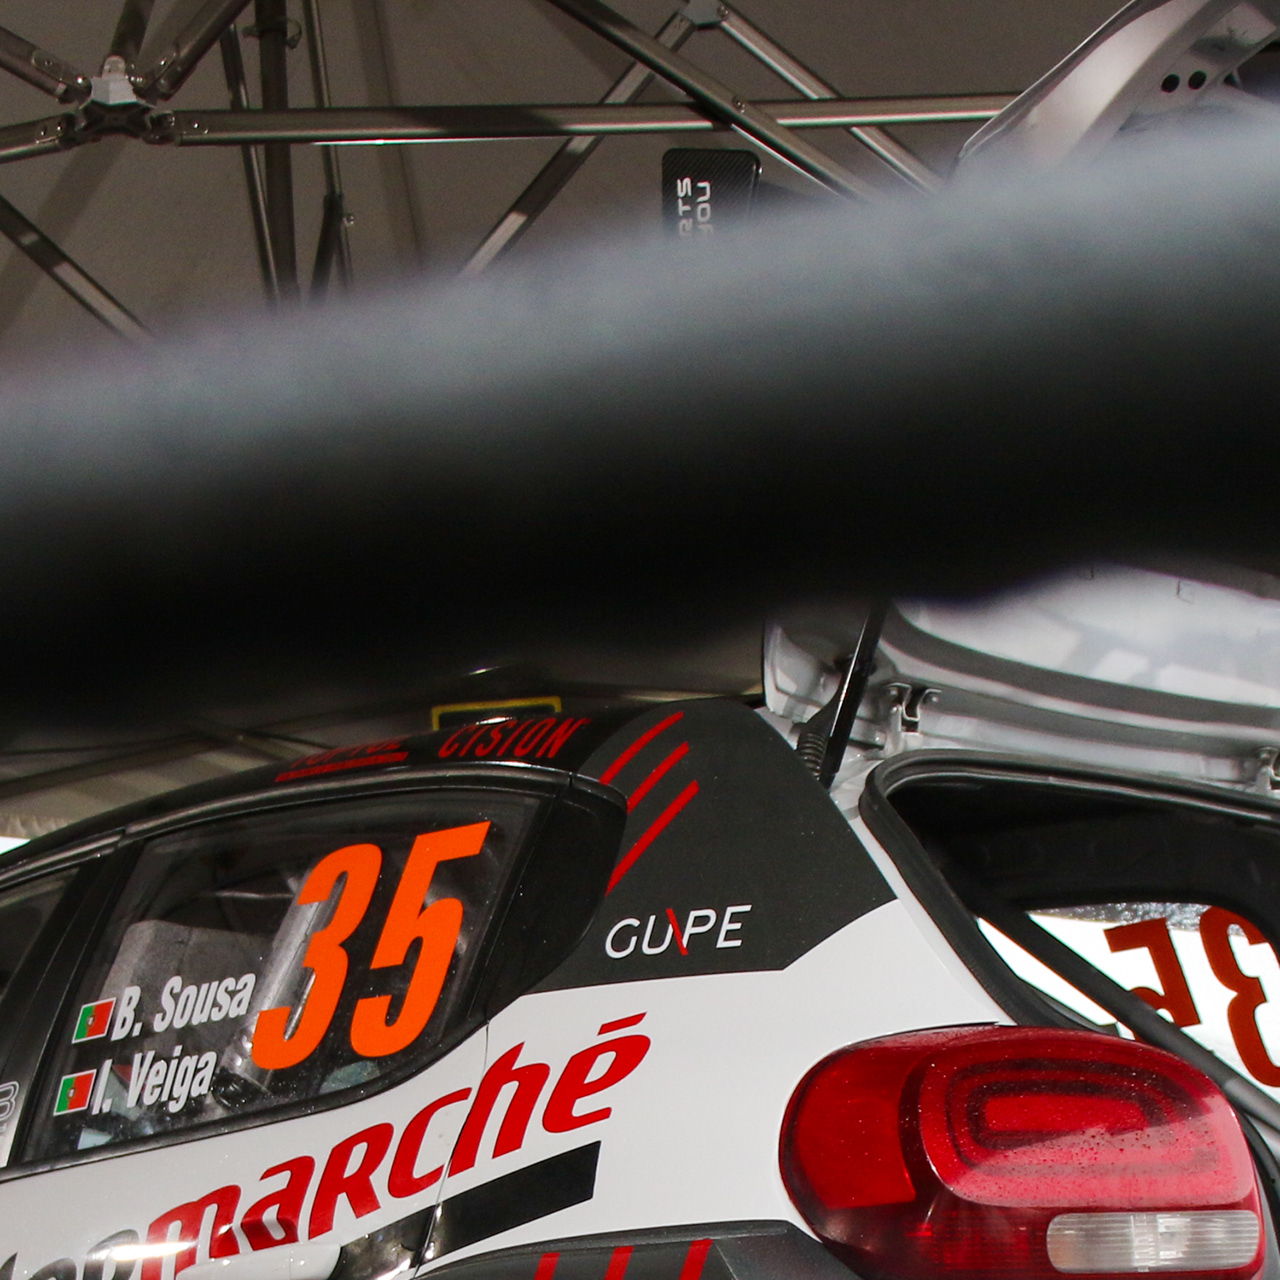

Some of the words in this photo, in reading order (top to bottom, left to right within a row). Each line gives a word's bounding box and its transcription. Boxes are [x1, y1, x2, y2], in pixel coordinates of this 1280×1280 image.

[676, 176, 694, 237] RTS
[251, 820, 492, 1071] 35
[604, 904, 753, 960] GUPE
[110, 985, 144, 1042] B.
[153, 972, 257, 1033] Sousa
[91, 1058, 113, 1116] I.
[126, 1044, 218, 1114] Veiga
